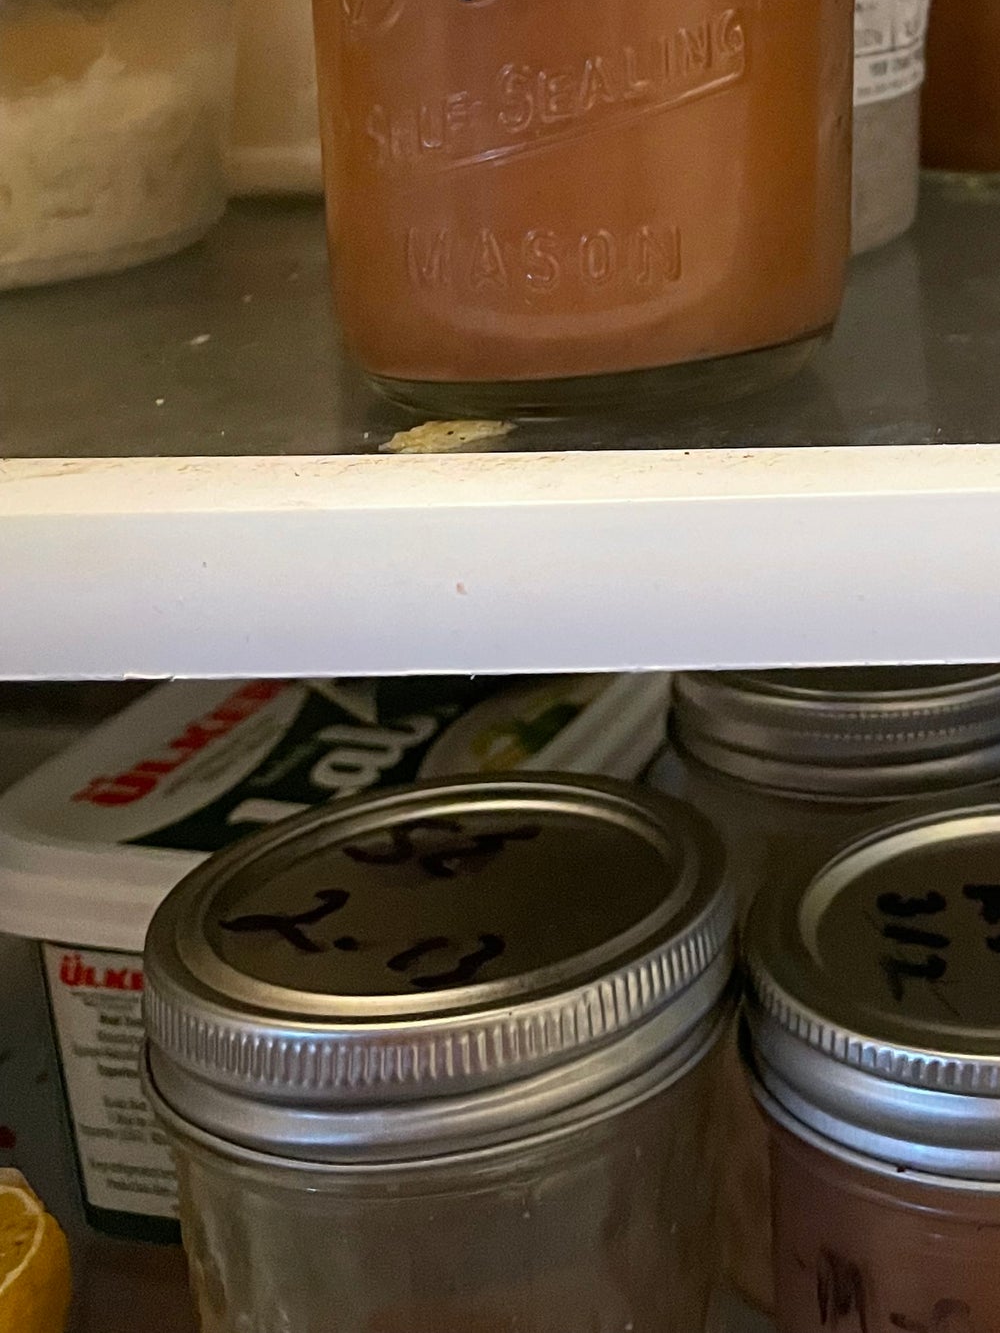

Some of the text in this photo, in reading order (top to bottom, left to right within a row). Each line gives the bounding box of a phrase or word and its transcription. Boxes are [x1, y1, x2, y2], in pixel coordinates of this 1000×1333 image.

[498, 6, 746, 132] SEALING
[405, 225, 683, 291] MASON
[59, 952, 143, 991] ÜLKE
